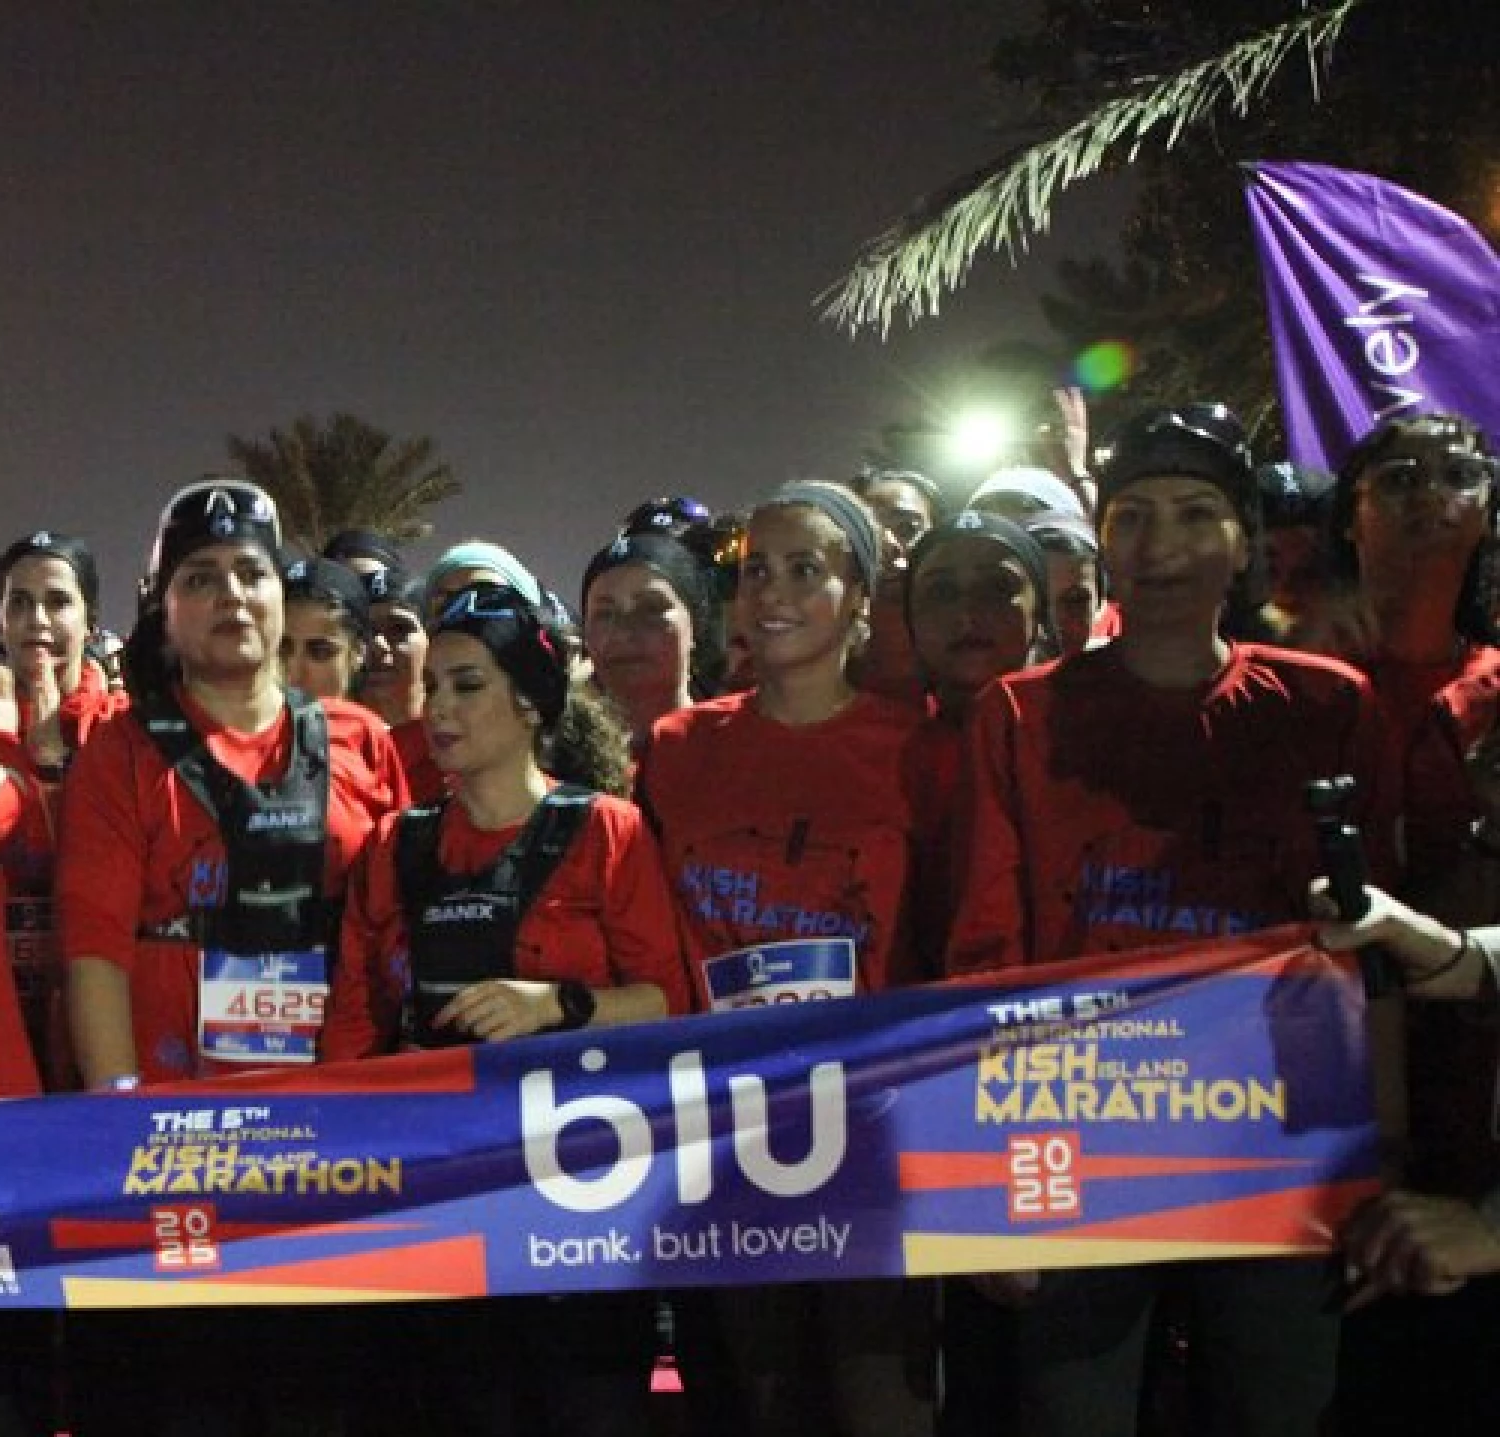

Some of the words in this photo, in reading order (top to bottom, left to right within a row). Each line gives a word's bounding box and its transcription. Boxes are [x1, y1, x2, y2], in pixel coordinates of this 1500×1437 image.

[1343, 273, 1429, 420] vely
[987, 997, 1063, 1024] THE
[976, 1042, 1098, 1083] KISH
[1098, 1058, 1189, 1078] ISLAND
[152, 1109, 214, 1131] THE
[974, 1078, 1288, 1125] MARATHON
[519, 1047, 848, 1213] blu
[122, 1156, 402, 1195] MARATHON
[130, 1146, 238, 1176] KISH
[1010, 1138, 1074, 1175] 20
[1012, 1175, 1080, 1213] 25
[155, 1208, 210, 1238] 20
[653, 1223, 722, 1261] but
[731, 1215, 852, 1261] lovely
[158, 1238, 218, 1265] 25
